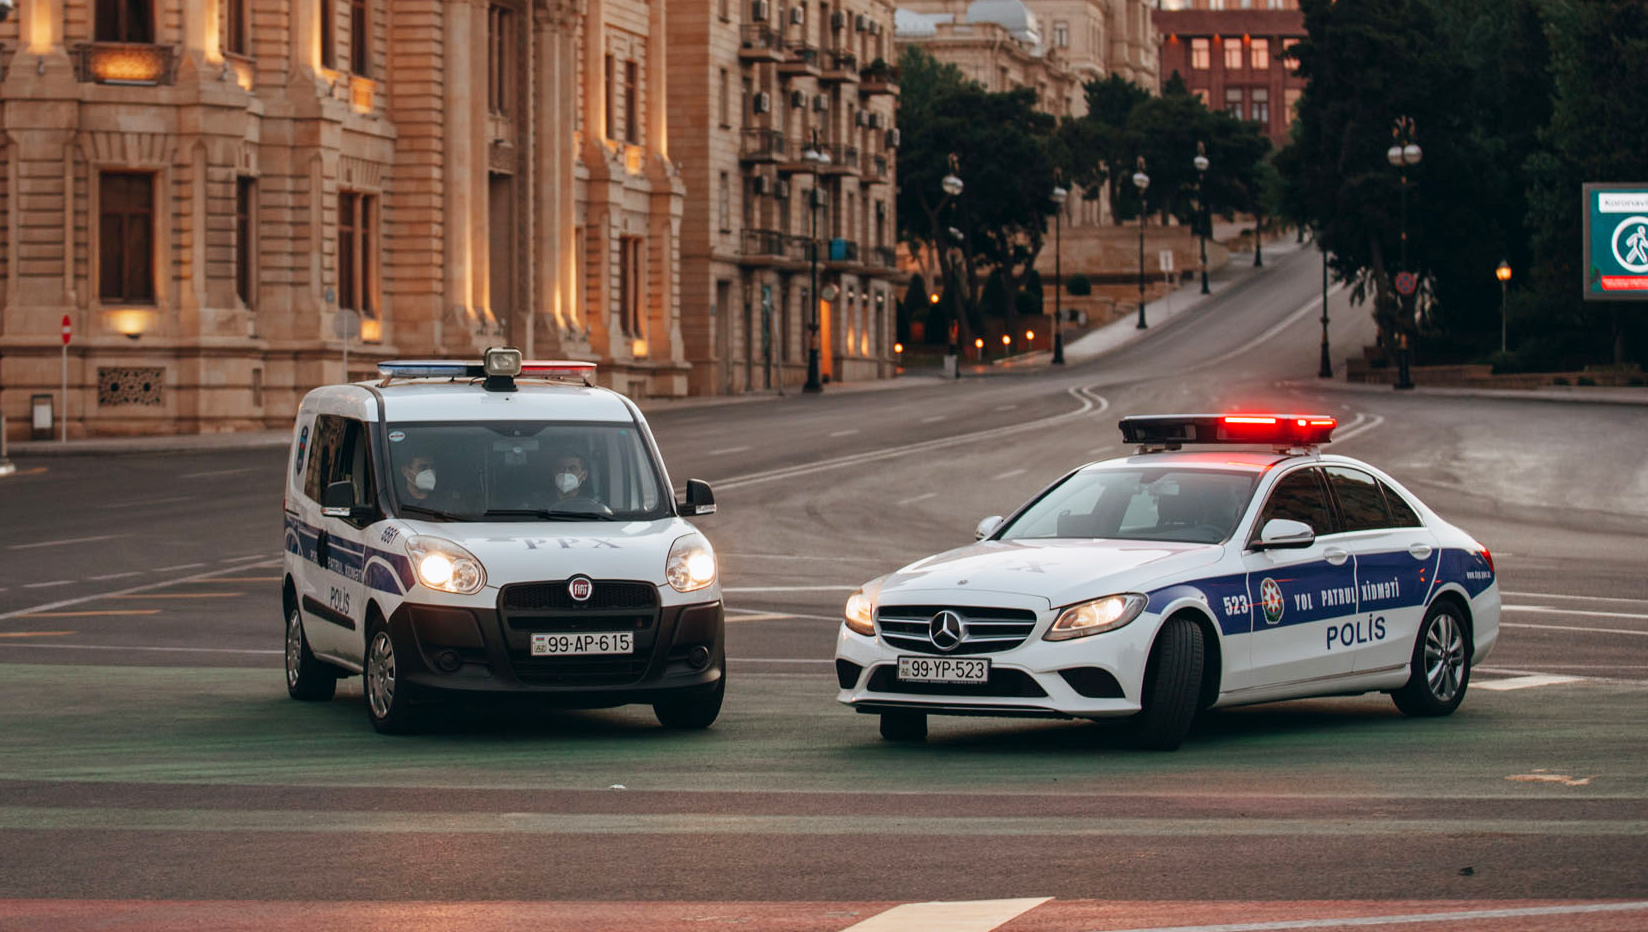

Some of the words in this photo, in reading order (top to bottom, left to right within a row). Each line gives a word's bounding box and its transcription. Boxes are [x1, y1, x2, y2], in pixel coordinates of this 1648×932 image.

[523, 538, 622, 549] PPX
[575, 584, 588, 595] FIAT
[1223, 594, 1248, 616] 523
[1294, 593, 1313, 611] YOL
[1321, 587, 1356, 607] PATRUL
[1327, 613, 1386, 650] POLİS
[548, 634, 630, 653] 99-AP-615
[911, 660, 985, 679] 99-YP-523
